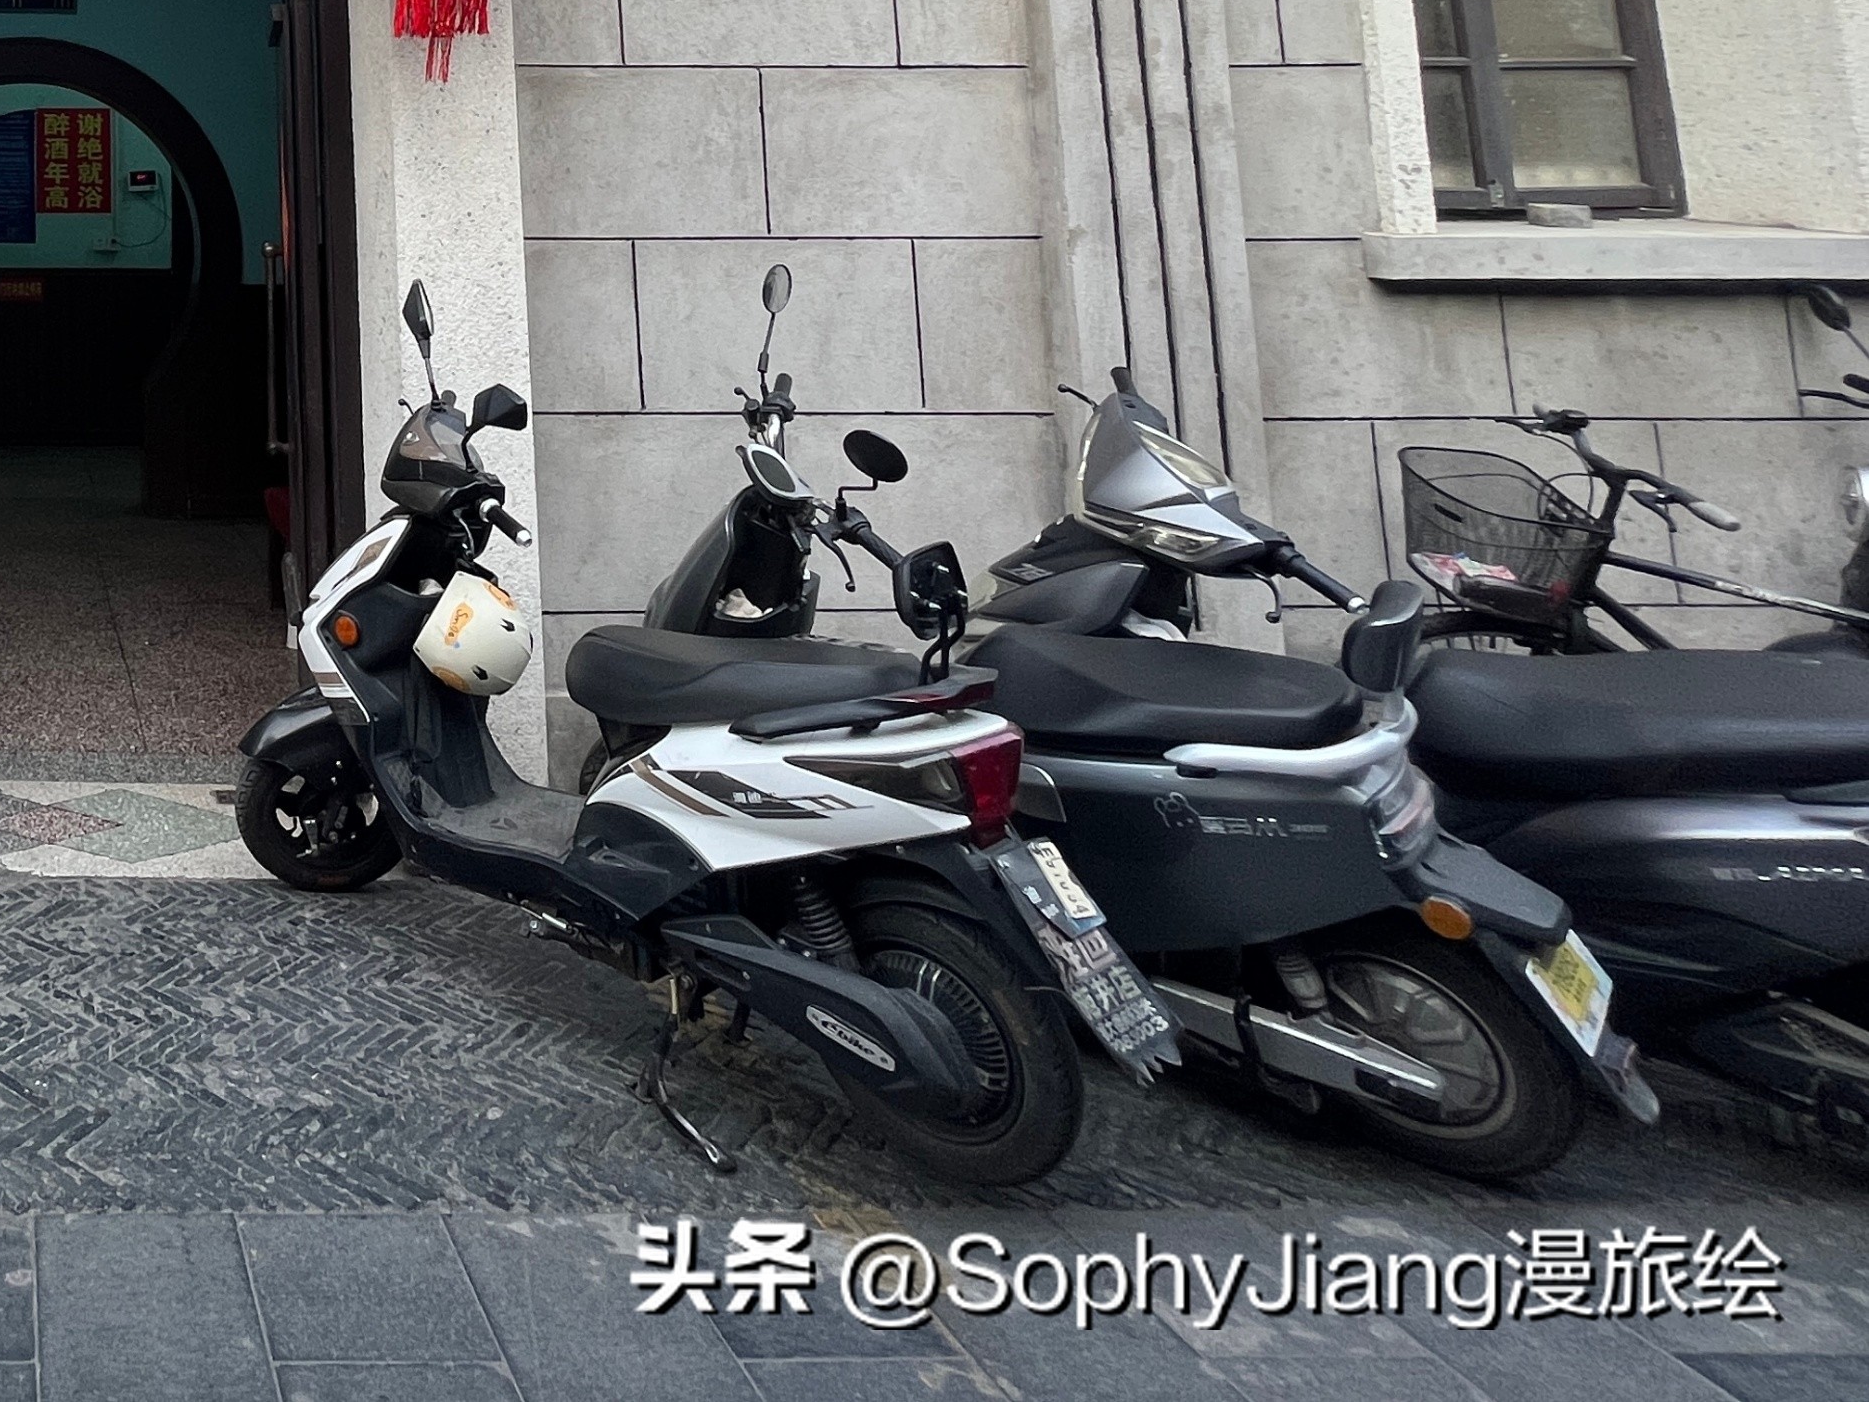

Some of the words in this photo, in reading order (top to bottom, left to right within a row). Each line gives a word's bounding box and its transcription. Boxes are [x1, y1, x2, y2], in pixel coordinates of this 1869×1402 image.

[44, 113, 71, 209] 醉酒年高
[77, 113, 104, 209] 谢绝就浴
